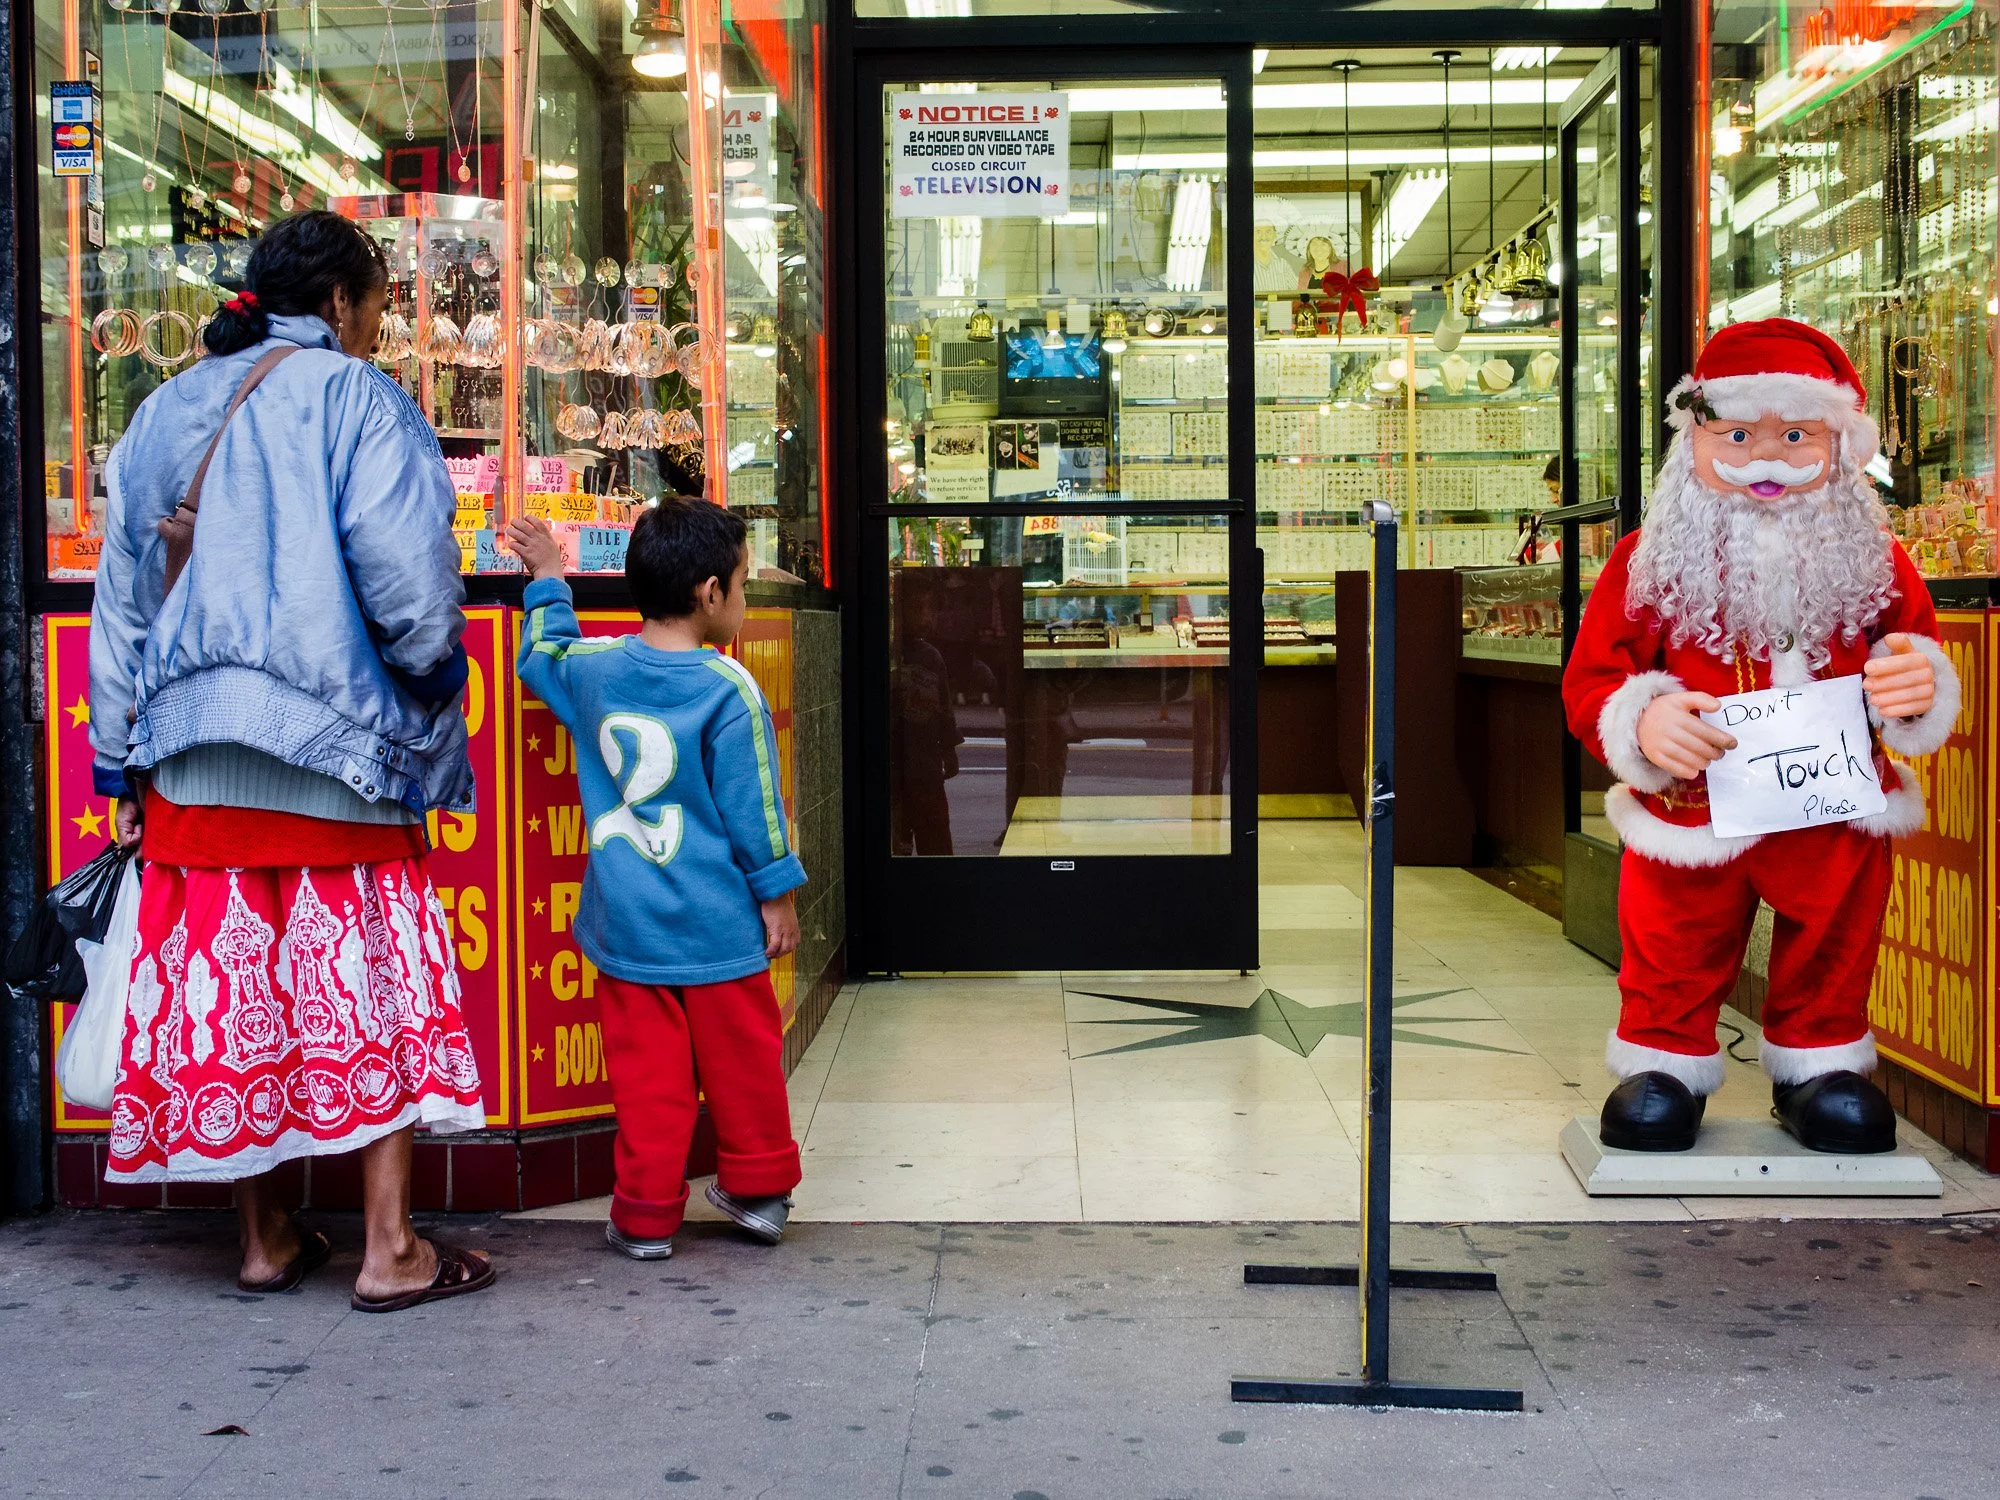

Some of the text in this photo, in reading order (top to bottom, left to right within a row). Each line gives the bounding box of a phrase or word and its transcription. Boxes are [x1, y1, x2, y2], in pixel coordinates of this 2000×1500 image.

[53, 87, 91, 95] CHOICE
[918, 106, 1024, 121] NOTICE
[909, 130, 1049, 142] 24 HOUR SURVEILLANCE
[903, 144, 1055, 156] RECORDED ON VIDEO TAPE
[61, 158, 87, 168] VISA
[931, 161, 1027, 171] CLOSED CIRCUIT
[914, 176, 1041, 194] TELEVISION
[448, 461, 476, 473] ALE
[560, 496, 594, 510] SALE
[589, 531, 621, 546] SALE
[1748, 730, 1873, 791] Touch
[591, 712, 684, 868] 2
[1937, 745, 1975, 843] ORO
[1803, 794, 1860, 821] Please
[1909, 858, 1931, 952] DE
[1936, 865, 1973, 968] ORO
[1867, 943, 1974, 1072] AZOS DE ORO
